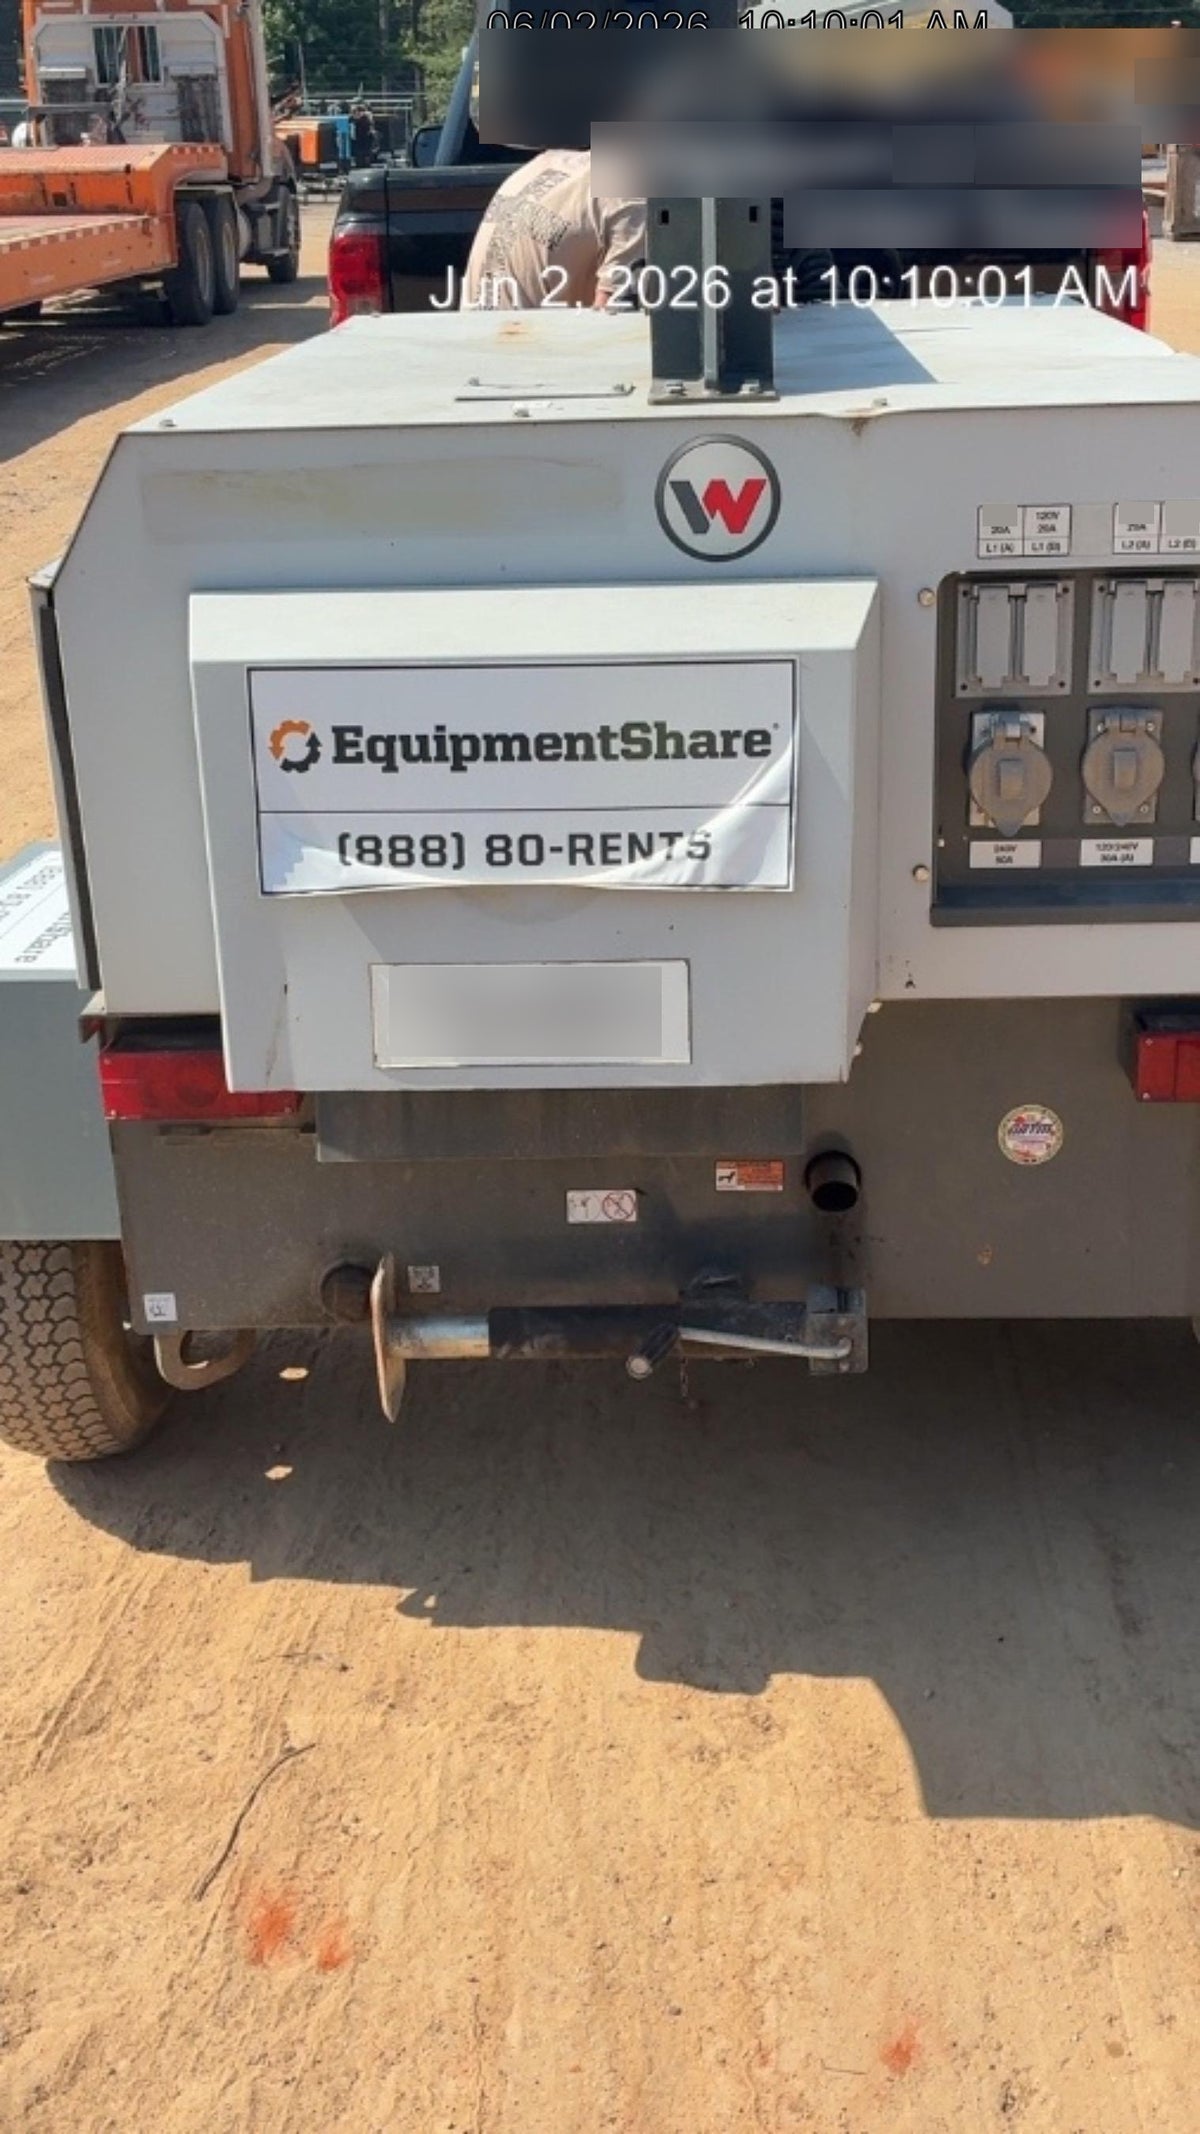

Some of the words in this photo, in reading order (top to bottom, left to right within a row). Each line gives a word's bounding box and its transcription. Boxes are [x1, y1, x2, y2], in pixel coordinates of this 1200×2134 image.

[331, 721, 773, 773] EquipmentShare
[338, 831, 466, 870] (888)
[485, 830, 713, 867] 80-RENTS
